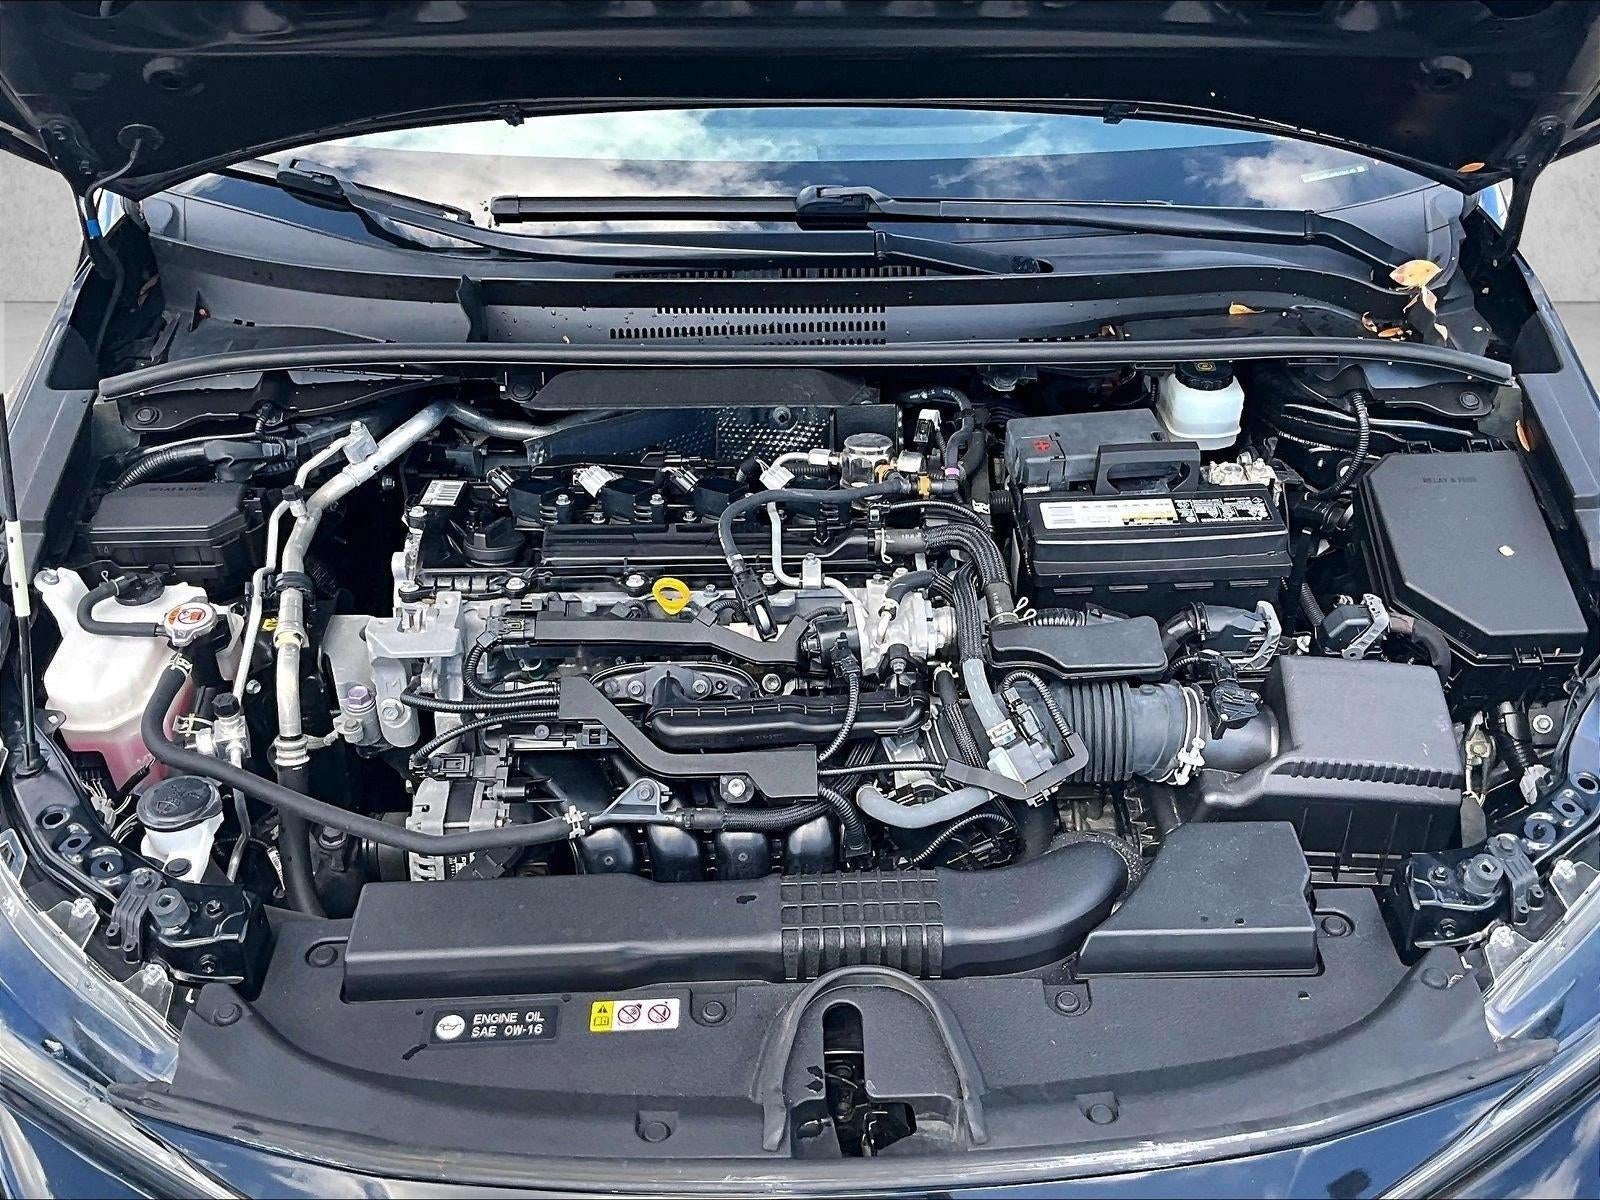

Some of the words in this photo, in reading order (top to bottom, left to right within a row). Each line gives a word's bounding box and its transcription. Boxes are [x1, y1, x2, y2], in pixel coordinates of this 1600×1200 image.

[473, 1012, 518, 1024] ENGINE
[525, 1011, 545, 1023] OIL
[471, 1026, 497, 1038] SAE
[504, 1023, 543, 1037] 0W-16
